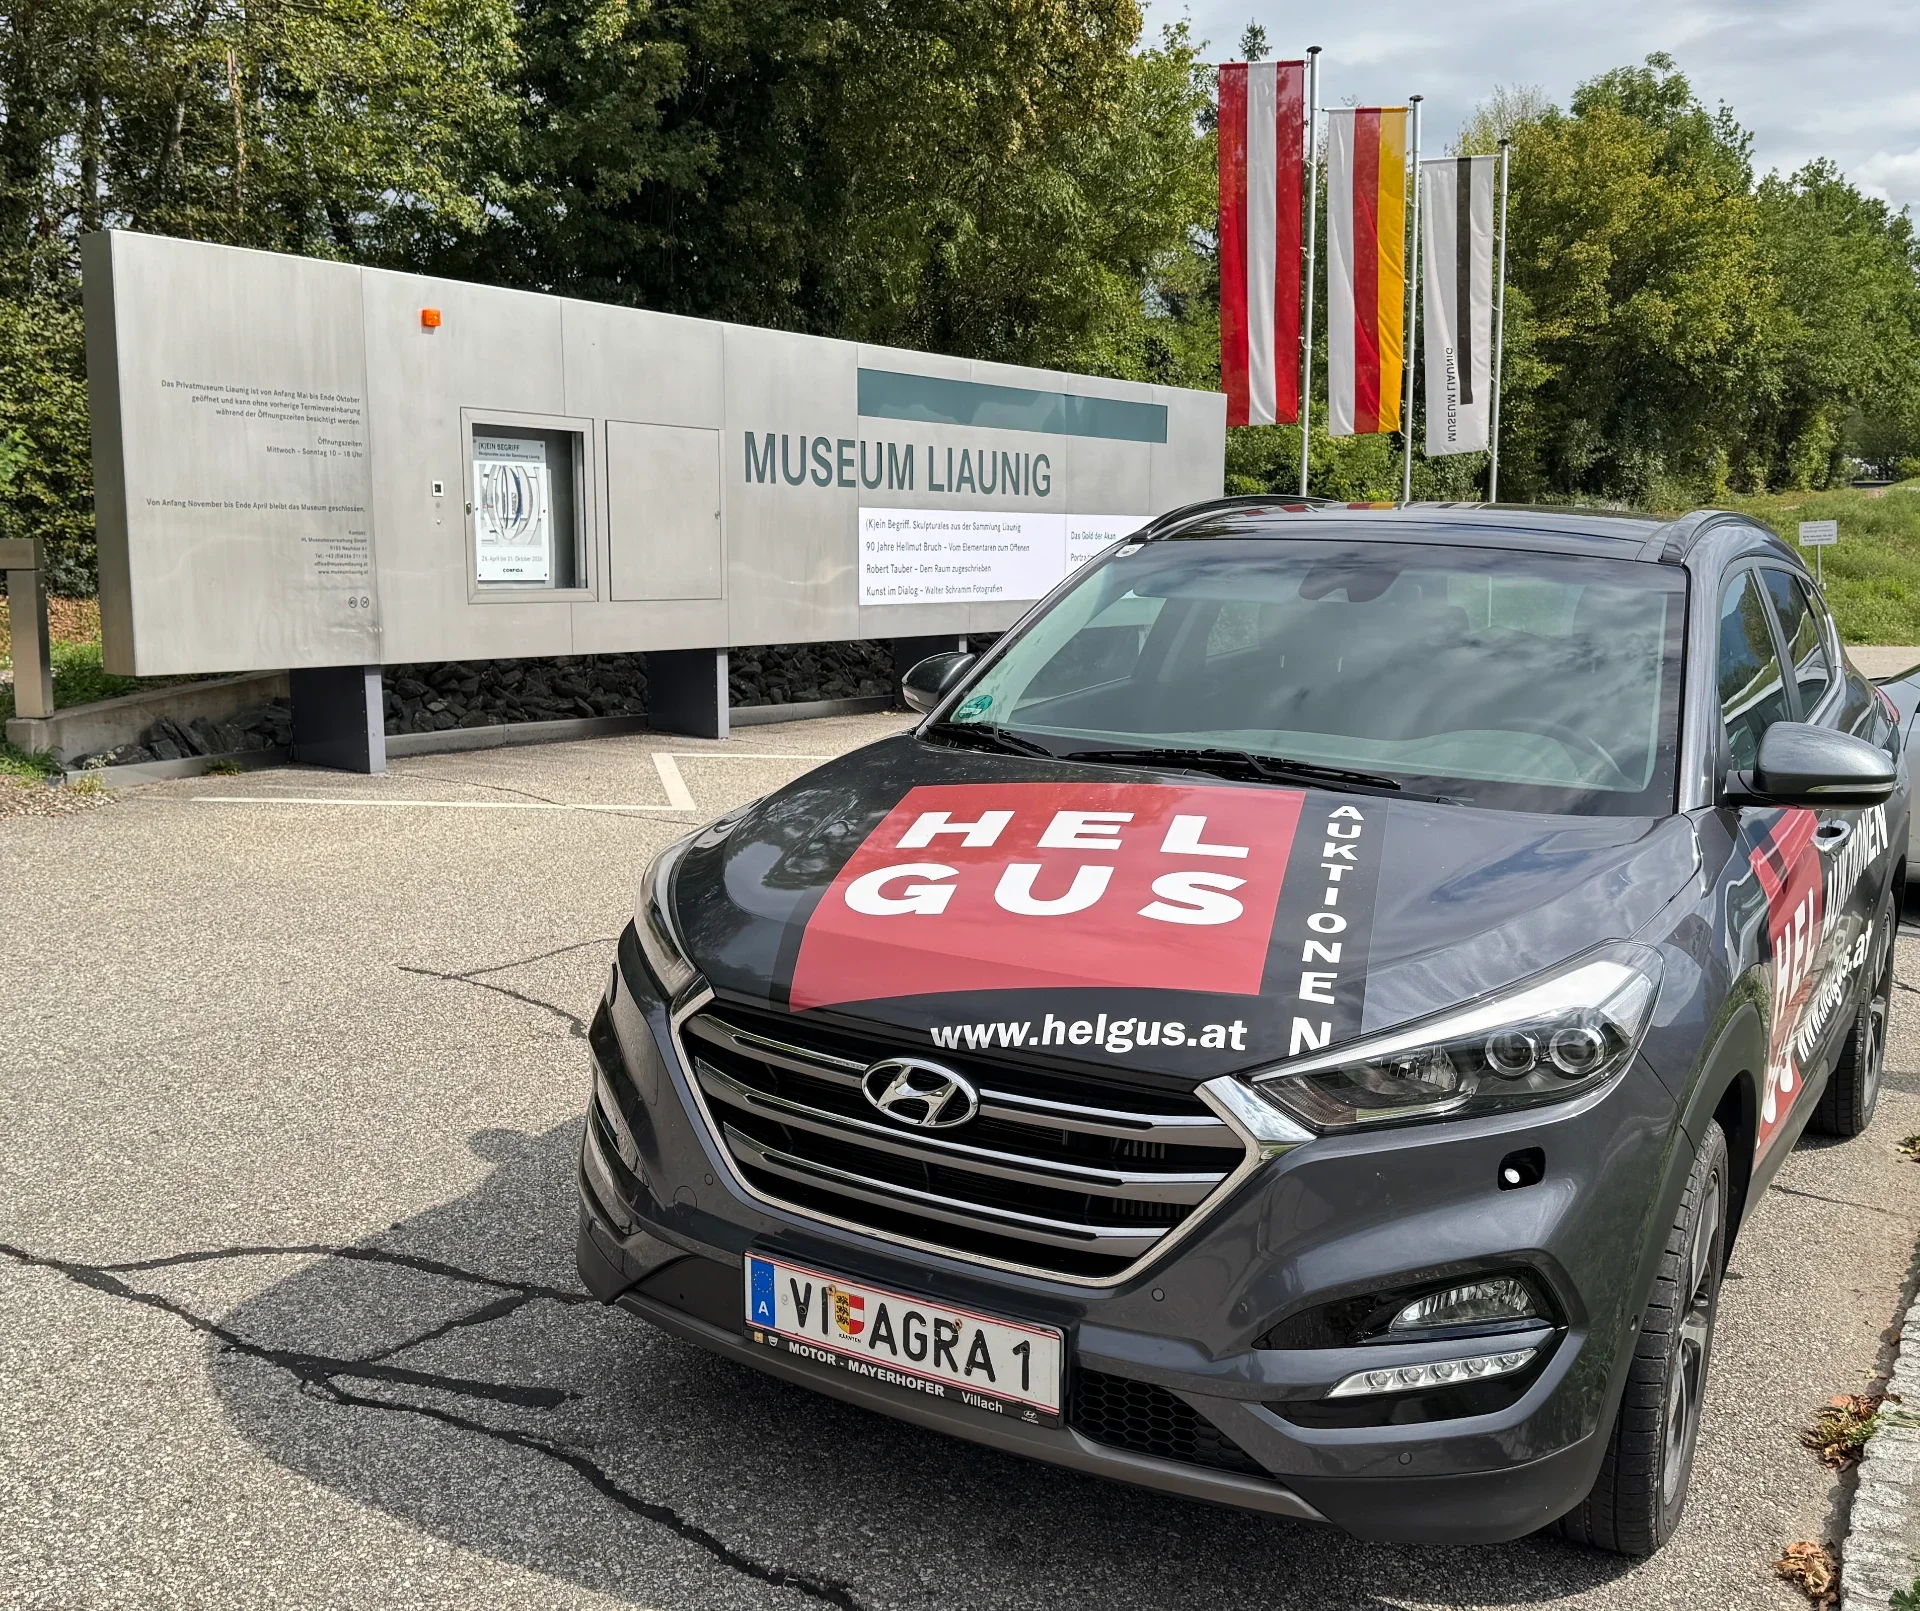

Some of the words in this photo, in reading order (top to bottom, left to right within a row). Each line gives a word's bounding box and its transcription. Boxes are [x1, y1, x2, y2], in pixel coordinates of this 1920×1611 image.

[176, 381, 224, 392] Privatmuseum
[226, 386, 249, 396] Liaunig
[274, 390, 295, 399] Anfang
[336, 395, 360, 403] Oktober
[192, 395, 220, 403] geöffnet
[270, 401, 299, 410] vorherige
[301, 403, 360, 416] Terminvereinbarung
[258, 410, 304, 421] Öffnungszeiten
[306, 416, 336, 425] besichtigt
[318, 436, 362, 447] Öffnungszeiten
[266, 446, 296, 454] Mittwoch
[302, 448, 327, 457] Sonntag
[744, 431, 914, 490] MUSEUM
[928, 446, 1052, 497] LIAUNIG
[162, 500, 186, 508] Anfang
[328, 505, 365, 513] geschlossen.
[866, 519, 886, 531] (K)ein
[888, 520, 911, 531] Begriff.
[913, 521, 949, 532] Skulpturales
[962, 522, 971, 530] der
[973, 523, 1001, 533] Sammlung
[1002, 523, 1021, 533] Liaunig
[1070, 531, 1080, 540] Das
[1082, 532, 1093, 540] Gold
[866, 542, 875, 551] 90
[877, 542, 894, 552] Jahre
[896, 542, 922, 551] Hellmut
[924, 542, 942, 551] Bruch
[963, 543, 996, 551] Elementaren
[866, 564, 889, 574] Robert
[891, 564, 912, 573] Tauber
[920, 565, 933, 573] Dem
[934, 565, 951, 573] Raum
[952, 564, 991, 574] zugeschrieben
[866, 587, 886, 596] Kunst
[888, 586, 896, 595] im
[898, 586, 918, 597] Dialog
[924, 586, 943, 595] Walter
[945, 585, 972, 594] Schramm
[973, 584, 1002, 594] Fotografien
[895, 810, 1249, 858] HEL
[844, 862, 1248, 926] GUS
[1289, 806, 1364, 1056] AUKTIONEN
[930, 1013, 1248, 1054] www.helgus.at
[758, 1300, 769, 1317] A
[790, 1277, 829, 1335] VI
[868, 1302, 996, 1382] AGRA
[1012, 1340, 1030, 1391] 1
[788, 1341, 836, 1367] MOTOR
[848, 1360, 945, 1397] MAYERHOFER
[961, 1391, 1003, 1414] Villach
